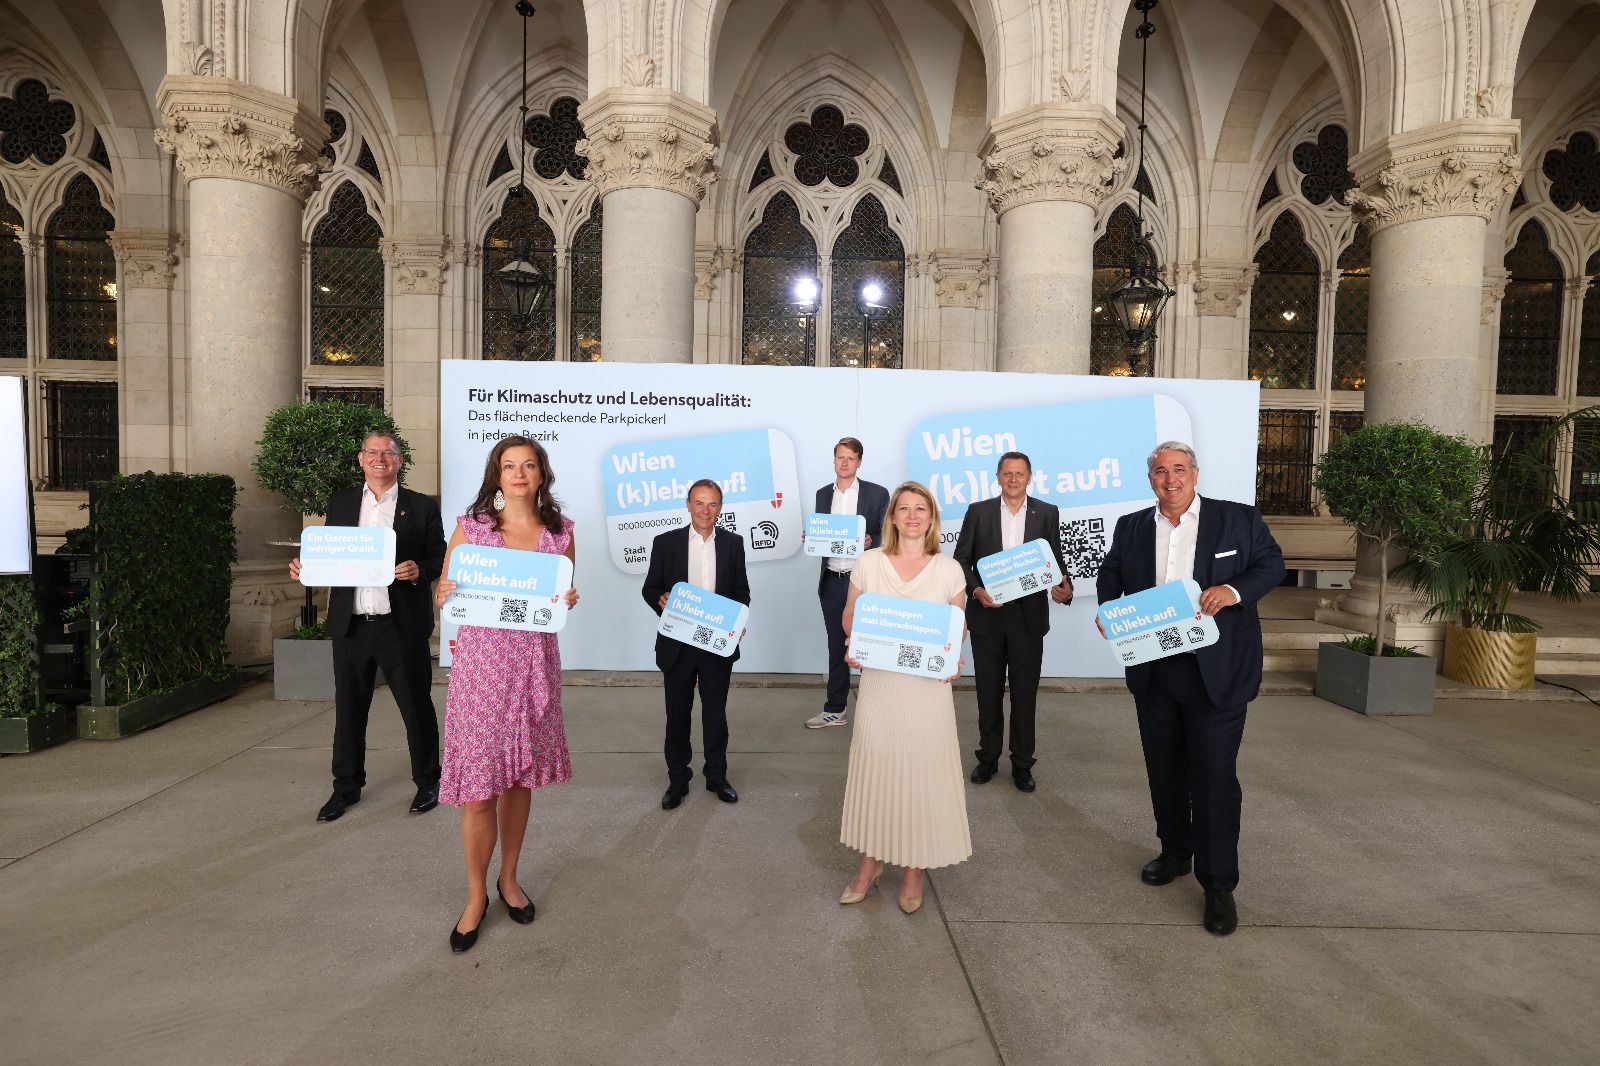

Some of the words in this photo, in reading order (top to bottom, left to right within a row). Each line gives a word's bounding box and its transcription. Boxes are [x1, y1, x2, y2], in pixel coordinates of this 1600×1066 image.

[468, 388, 494, 403] Für
[497, 389, 593, 404] Klimaschutz
[596, 391, 626, 405] und
[630, 391, 752, 410] Lebensqualität:
[468, 410, 491, 422] Das
[494, 410, 597, 423] flächendeckende
[600, 412, 666, 427] Parkpickerl
[468, 429, 479, 440] in
[522, 429, 559, 442] Bezirk
[922, 426, 1017, 461] Wien
[612, 451, 676, 475] Wien
[1056, 456, 1122, 494] auf!
[616, 478, 695, 509] (k)leb
[810, 517, 829, 526] Wien
[307, 533, 323, 542] Ein
[754, 539, 772, 547] RFID
[623, 545, 646, 556] Stadt
[624, 554, 647, 564] Wien
[459, 551, 498, 568] Wien
[456, 569, 507, 589] (k)lebt
[508, 577, 538, 591] auf!
[677, 587, 702, 604] Wien
[671, 598, 705, 618] (k)lebt
[704, 612, 725, 625] auf!
[861, 603, 879, 613] Luft
[879, 607, 924, 620] schnappen
[1103, 604, 1137, 620] Wien
[1110, 614, 1153, 636] (k)lebt
[1153, 606, 1178, 623] auf!
